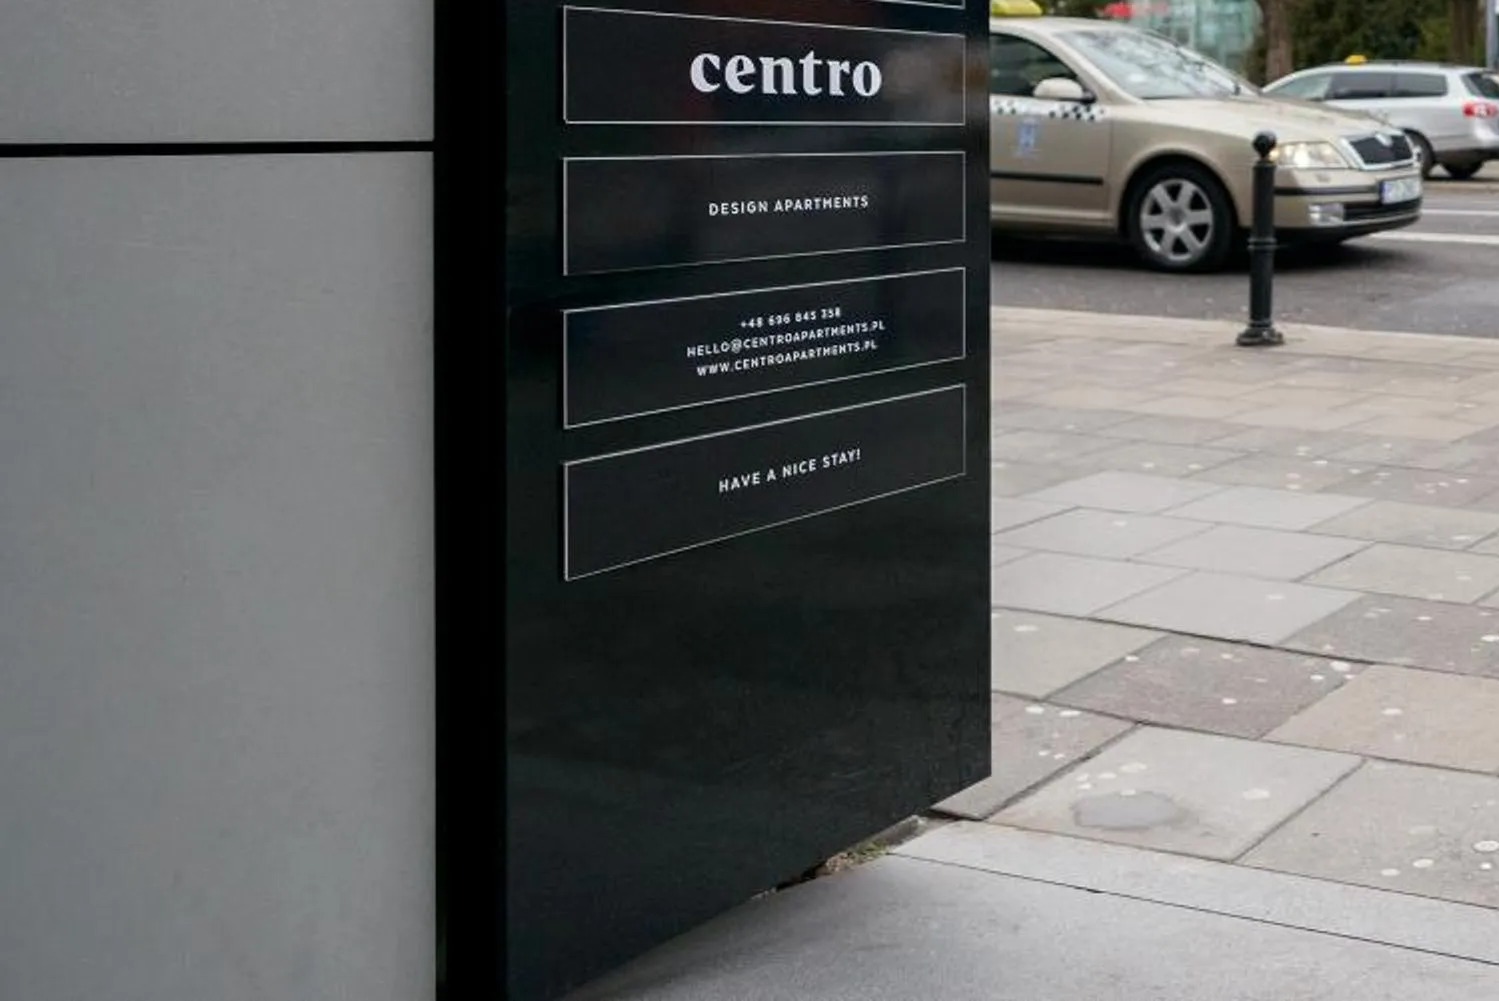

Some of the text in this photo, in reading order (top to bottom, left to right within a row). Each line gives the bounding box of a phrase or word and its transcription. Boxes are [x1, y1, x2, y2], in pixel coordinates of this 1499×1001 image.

[690, 50, 882, 97] centro
[708, 195, 869, 216] DESIGN APARTMENTS
[687, 320, 885, 358] HELLO@CENTROAPARTMENTS.PL
[741, 317, 763, 328] +48
[697, 340, 877, 376] WWW.CENTROAPARTMENTS.PL
[719, 448, 861, 493] HAVE A NICE STAY!
